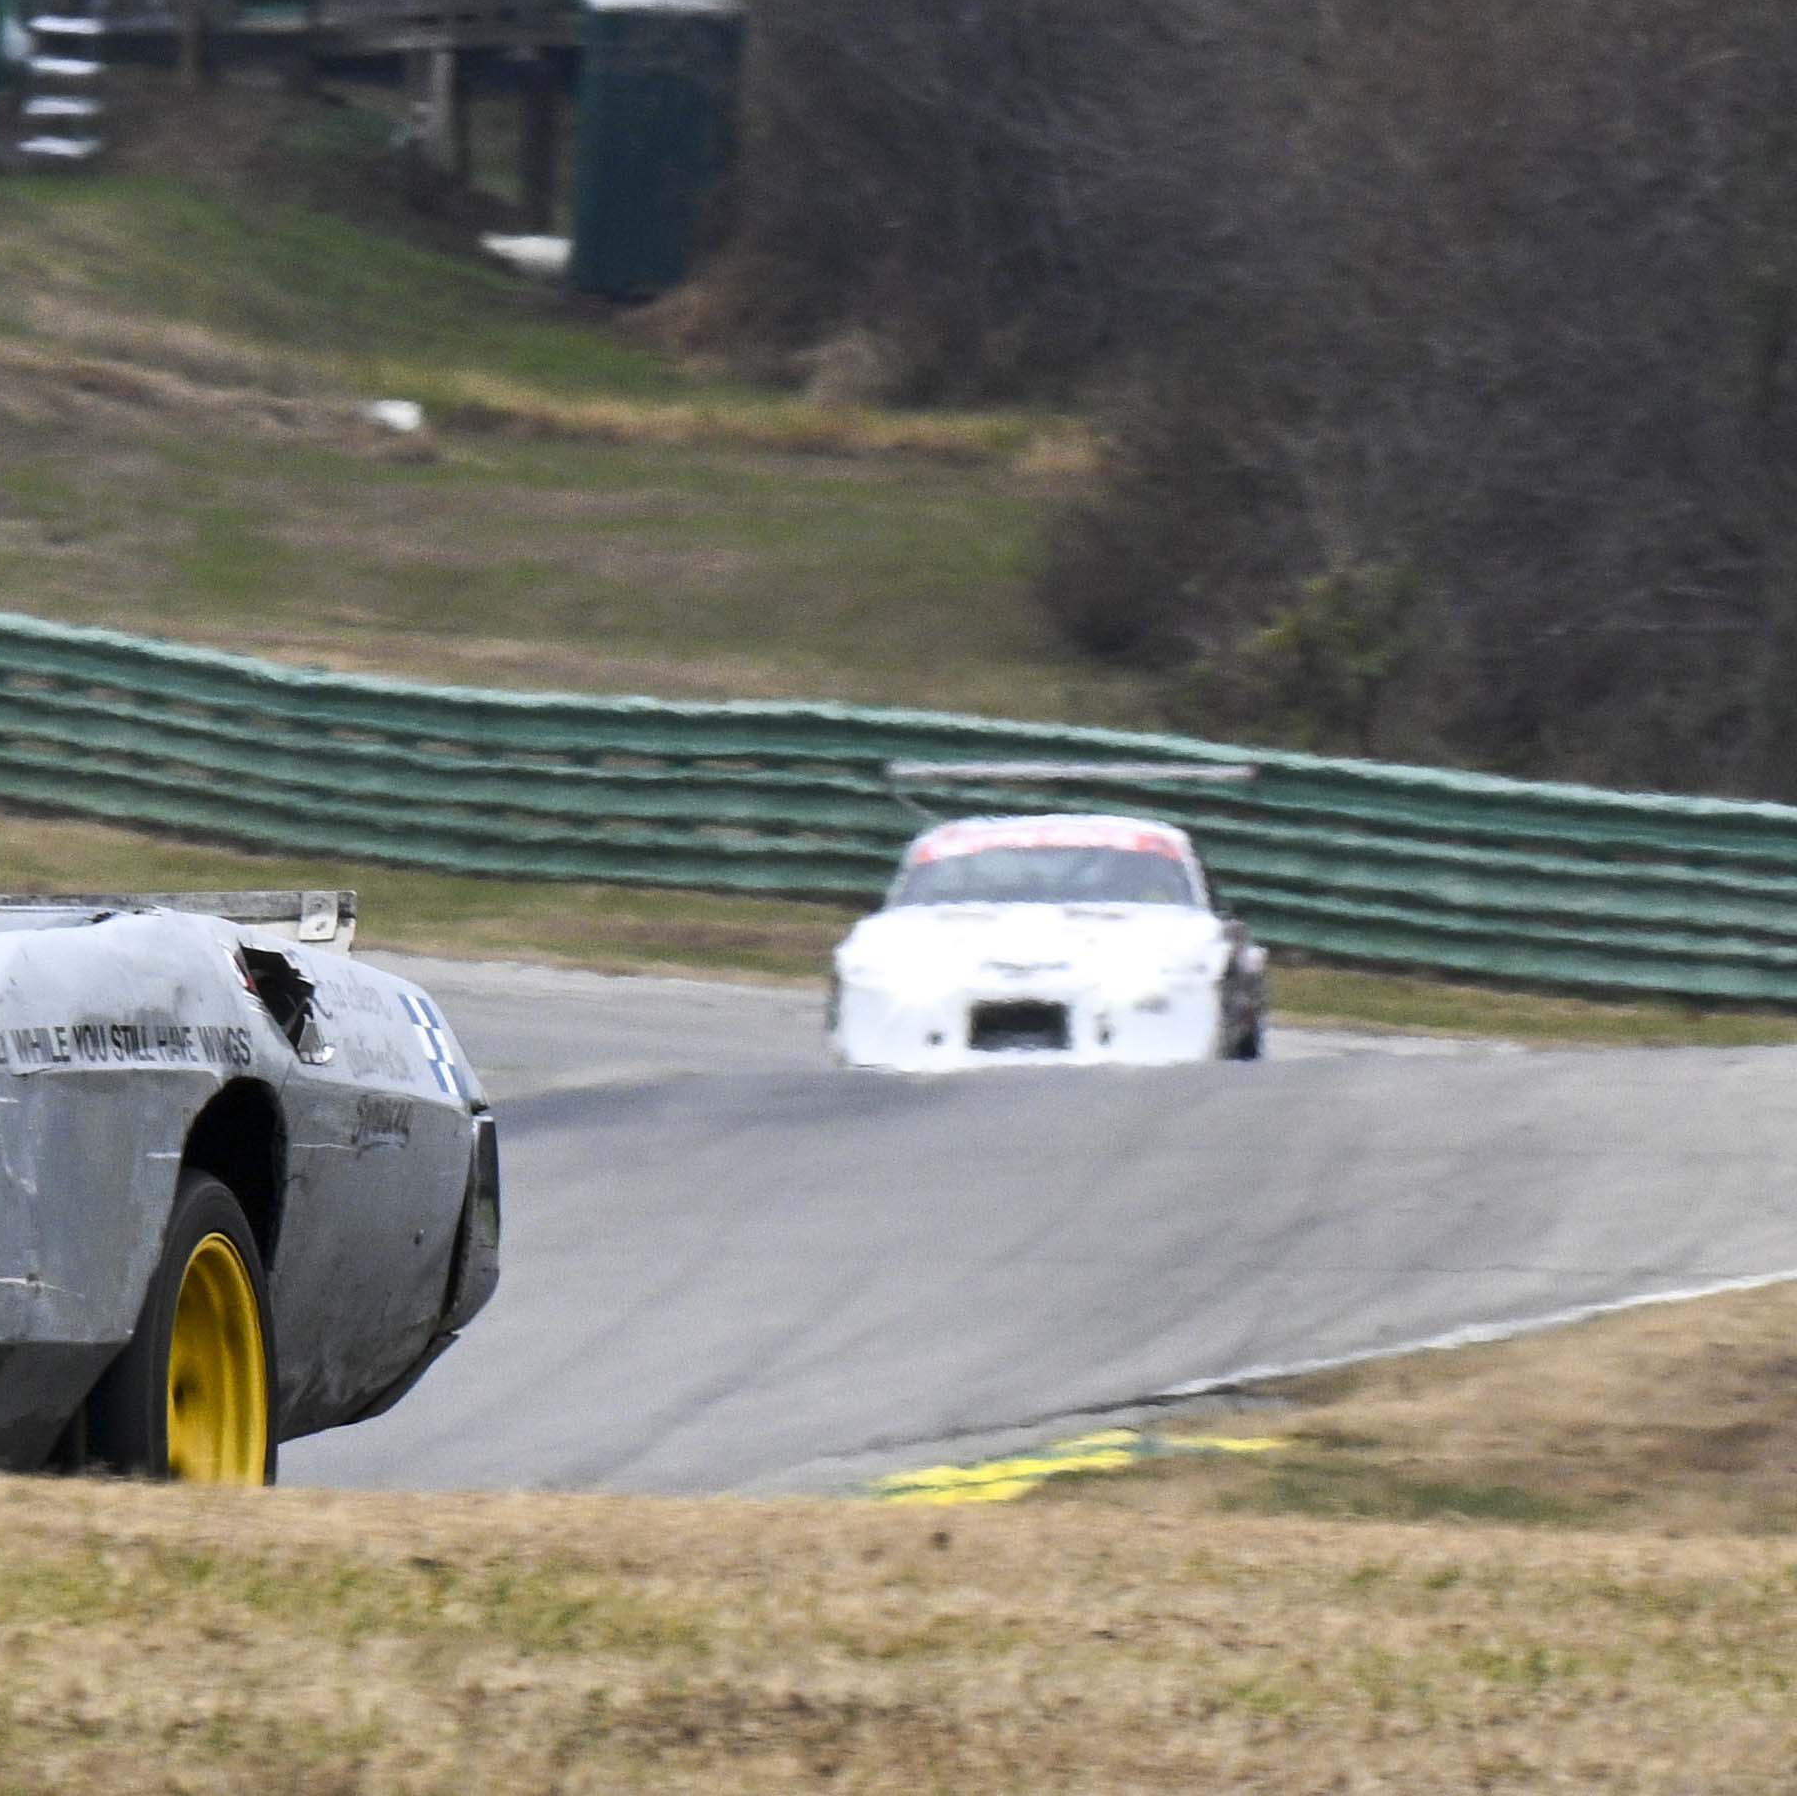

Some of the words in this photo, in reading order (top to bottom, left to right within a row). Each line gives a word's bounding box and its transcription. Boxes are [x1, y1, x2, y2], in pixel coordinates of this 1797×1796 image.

[72, 1023, 108, 1062] YOU
[111, 1023, 155, 1062] STILL
[157, 1025, 198, 1062] HAVE
